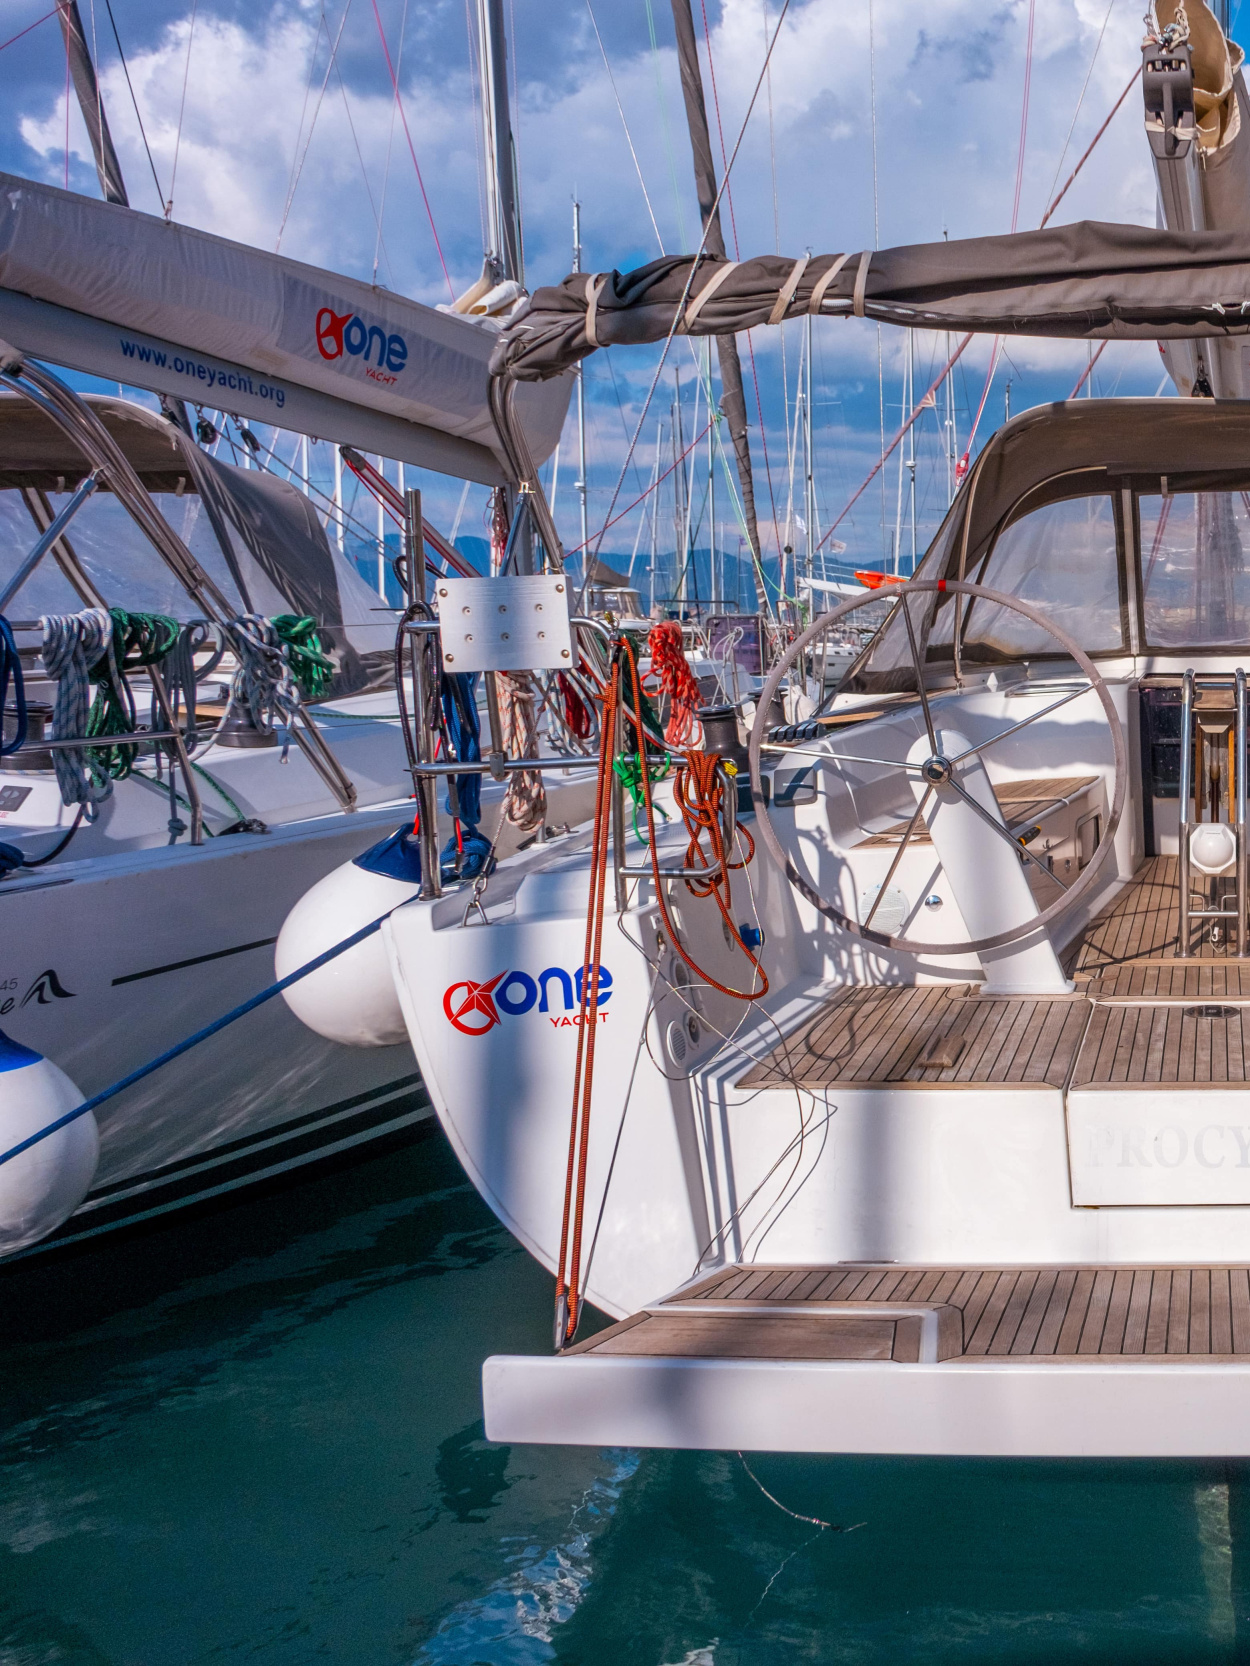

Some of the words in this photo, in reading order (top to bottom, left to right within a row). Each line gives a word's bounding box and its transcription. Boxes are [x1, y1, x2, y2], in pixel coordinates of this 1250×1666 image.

[344, 316, 408, 372] one
[120, 339, 285, 408] www.oneyacht.org
[365, 366, 397, 386] YACHT
[0, 977, 19, 991] 45
[495, 963, 614, 1016] one
